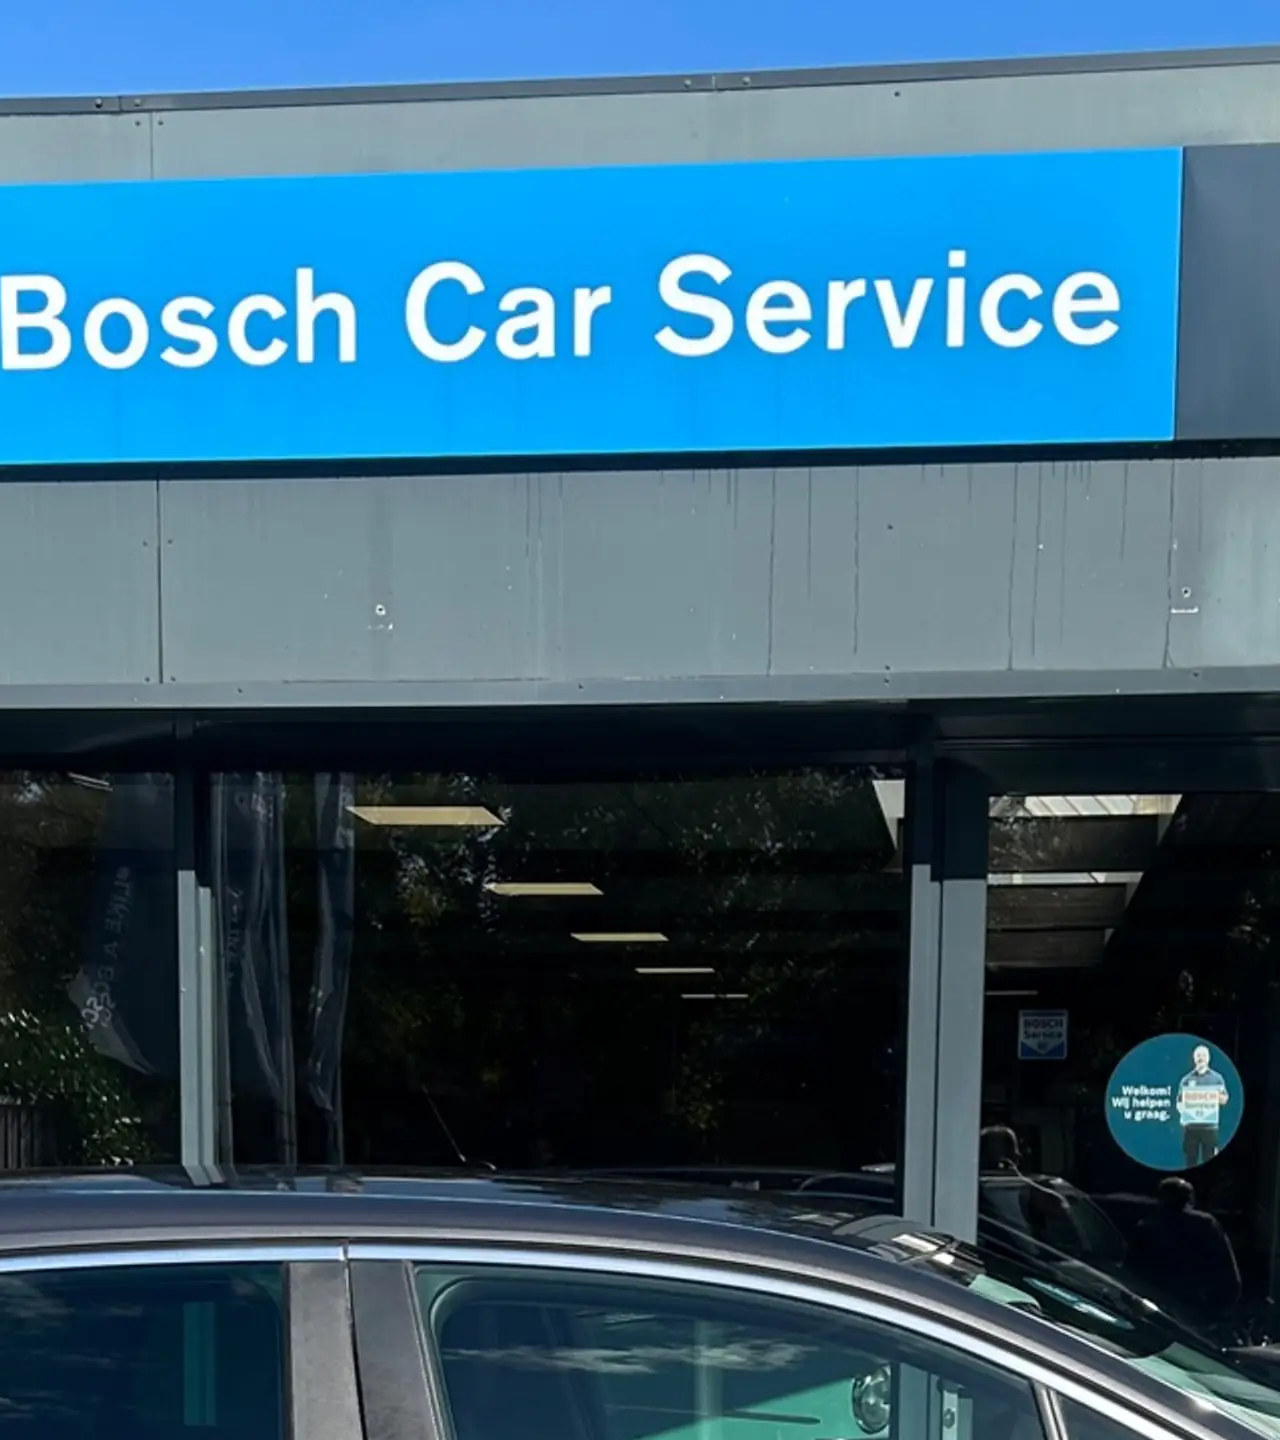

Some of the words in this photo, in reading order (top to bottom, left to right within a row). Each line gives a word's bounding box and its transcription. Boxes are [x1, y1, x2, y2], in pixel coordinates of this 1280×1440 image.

[404, 260, 612, 363] Car
[653, 249, 1121, 358] Service
[1121, 1085, 1171, 1097] Welkom!
[1111, 1097, 1131, 1110] Wij
[1132, 1097, 1171, 1110] helpen
[1124, 1111, 1132, 1120] u
[1134, 1110, 1171, 1122] graag.
